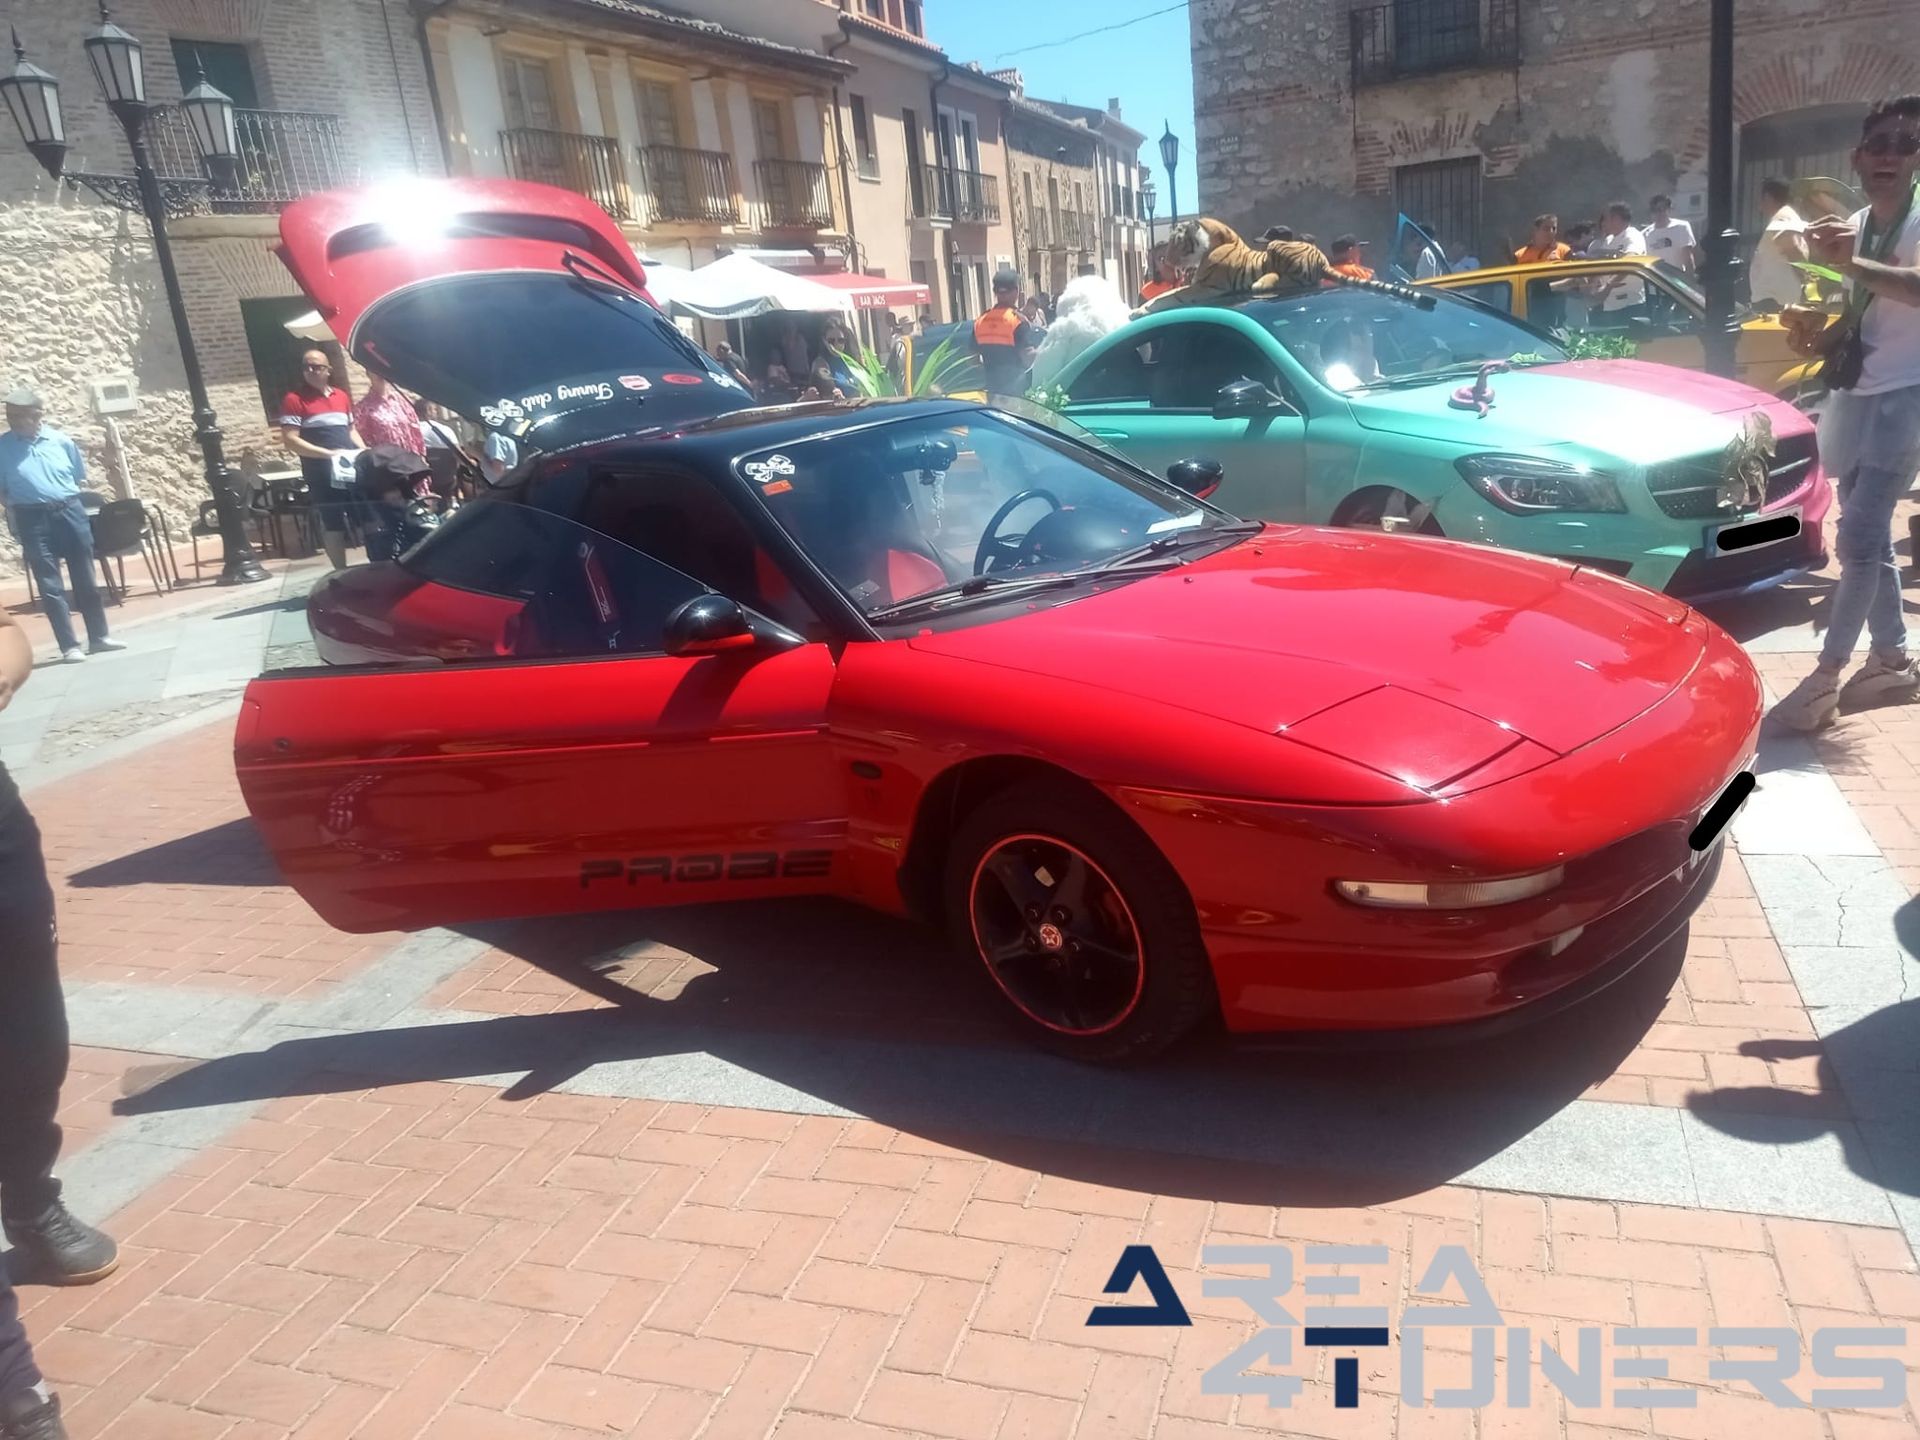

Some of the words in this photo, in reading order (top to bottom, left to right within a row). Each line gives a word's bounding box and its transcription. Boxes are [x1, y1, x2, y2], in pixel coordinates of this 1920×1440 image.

[557, 382, 614, 401] Tuning
[521, 392, 553, 412] club
[580, 849, 833, 890] PROBE
